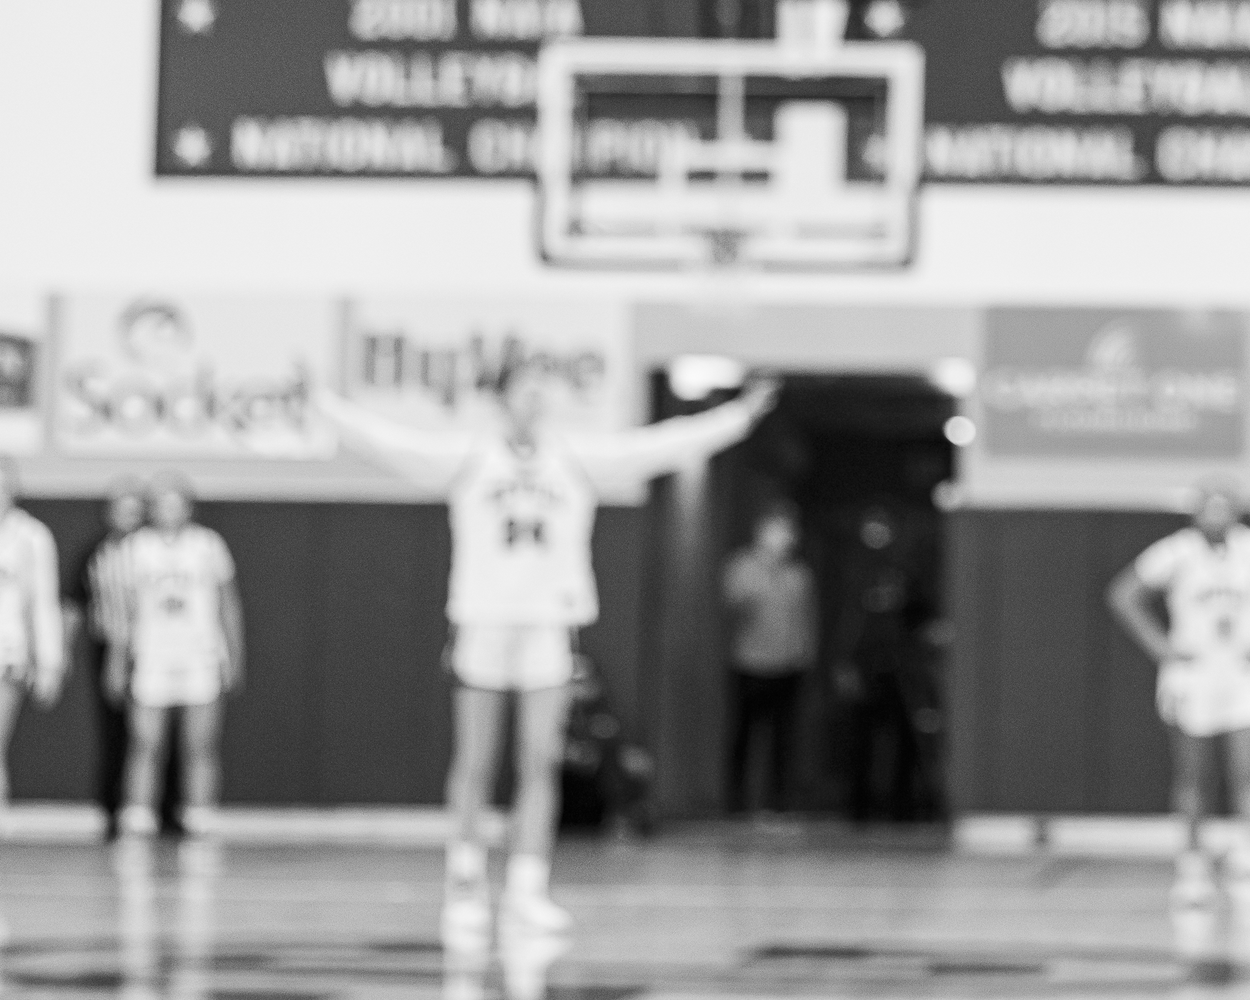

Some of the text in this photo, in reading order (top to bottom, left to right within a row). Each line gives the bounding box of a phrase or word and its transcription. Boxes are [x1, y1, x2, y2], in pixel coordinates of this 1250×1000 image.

[235, 117, 457, 171] NATIONAL
[928, 126, 1147, 178] NATIONAL
[66, 358, 310, 437] Socket
